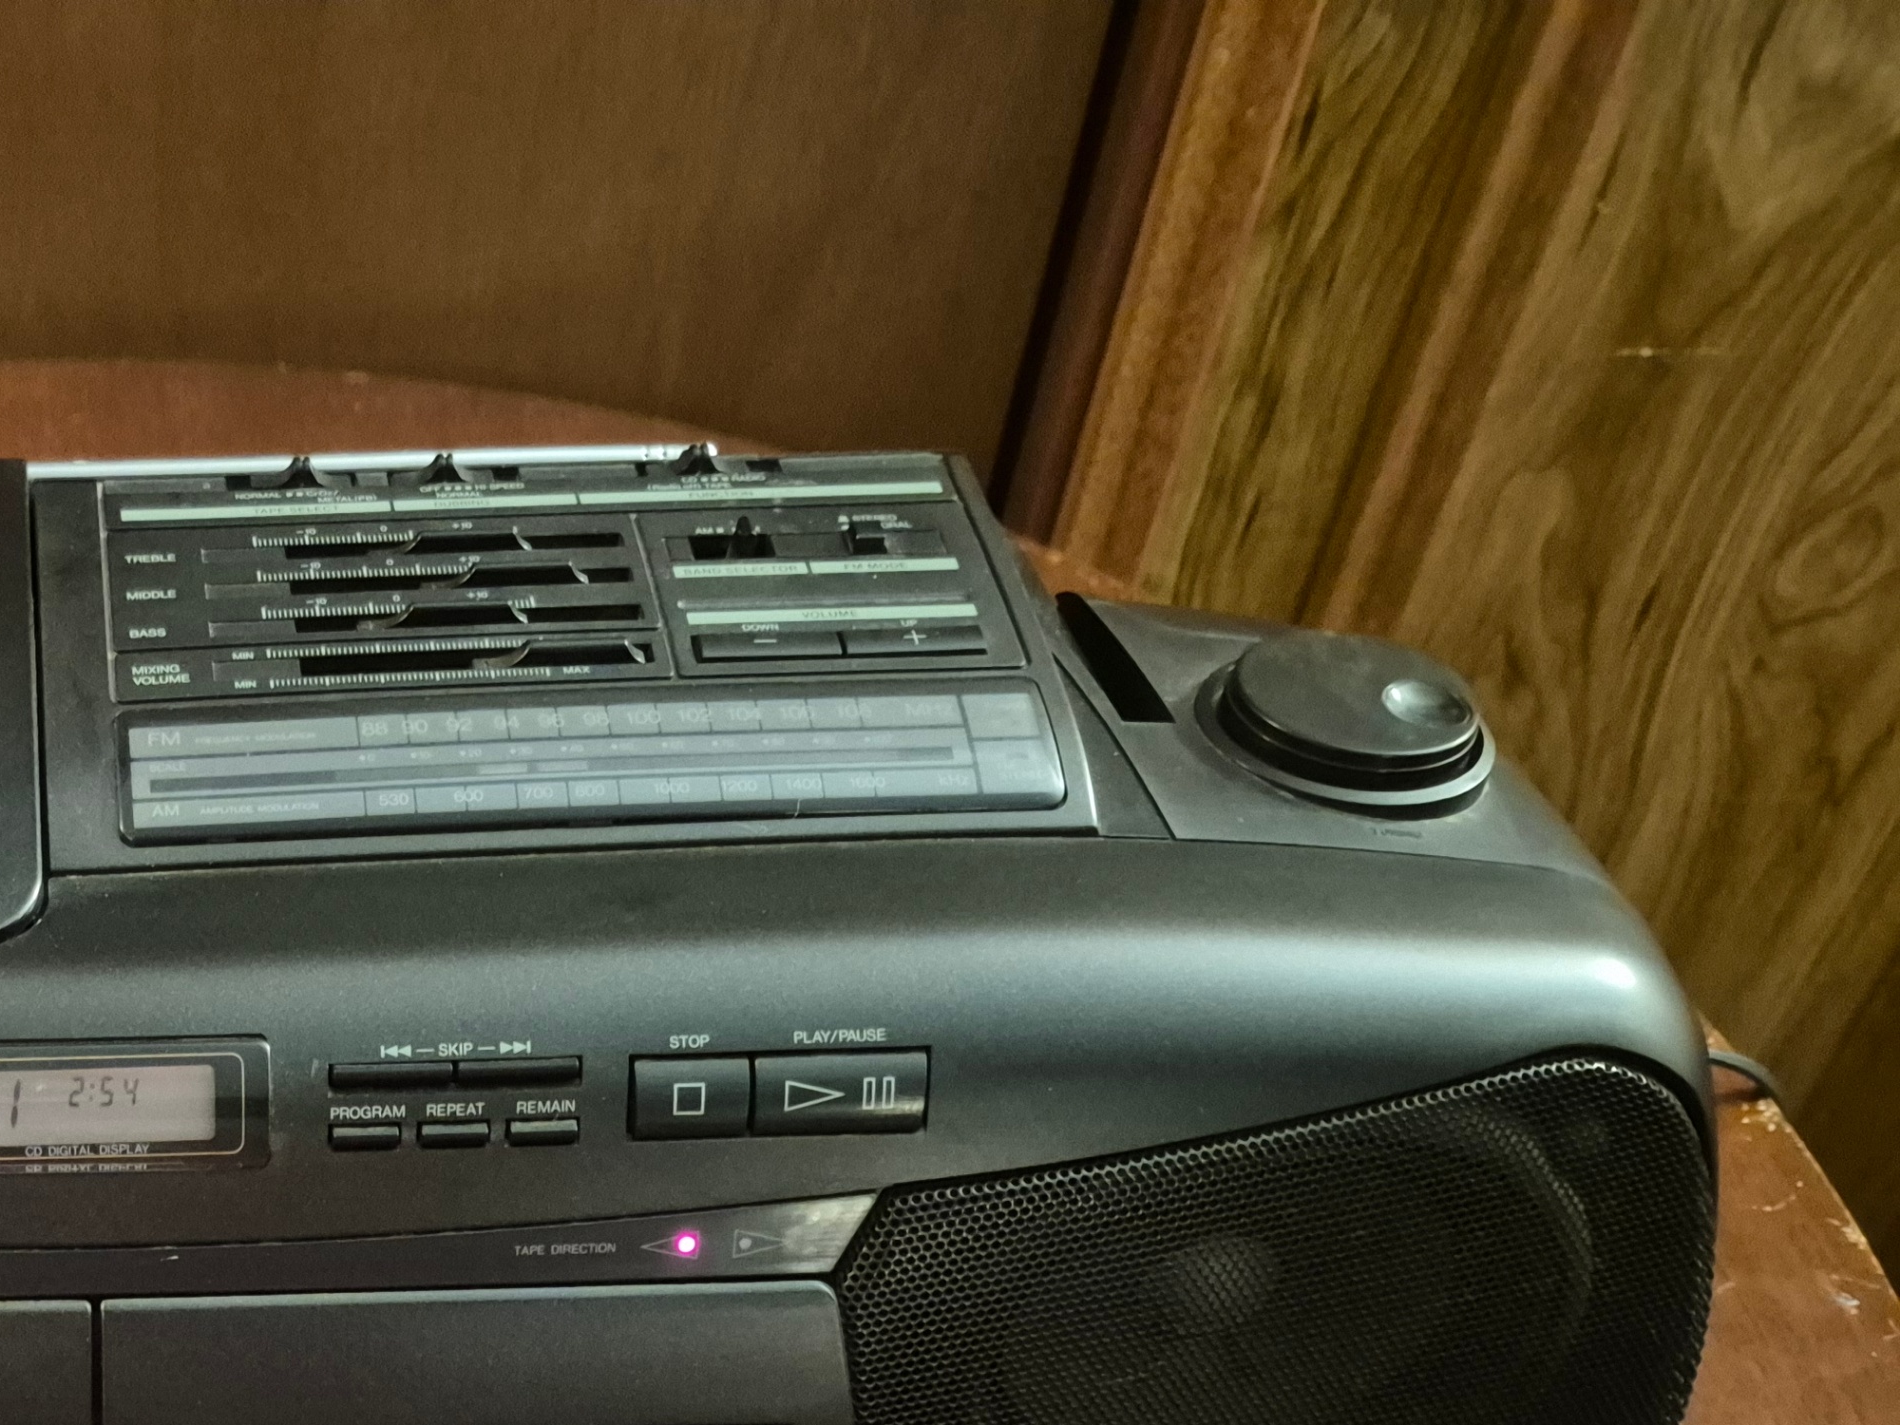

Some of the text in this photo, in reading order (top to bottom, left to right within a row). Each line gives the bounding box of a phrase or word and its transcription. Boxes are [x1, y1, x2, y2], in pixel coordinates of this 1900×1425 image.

[235, 491, 281, 500] NORMAL
[125, 553, 177, 565] TREBLE
[865, 561, 907, 571] MODE
[683, 564, 798, 577] BAND SELECTOR
[126, 589, 177, 601] MIDDLE
[801, 609, 858, 619] VOLUME
[129, 627, 167, 639] BASS
[741, 619, 918, 633] DOWN UP
[232, 651, 255, 661] MIN
[131, 664, 181, 676] MIXING
[132, 673, 191, 686] VOLUME
[234, 665, 591, 690] MIN MAX
[148, 732, 181, 747] FM
[361, 721, 389, 736] 88
[402, 719, 429, 734] 90
[446, 717, 473, 732] 92
[627, 710, 662, 725] 100
[678, 708, 712, 723] 102
[728, 706, 761, 721] 104
[904, 702, 953, 717] MHz
[152, 804, 180, 817] AM
[379, 793, 409, 807] 530
[454, 789, 484, 803] 600
[524, 786, 554, 800] 700
[575, 784, 605, 798] 800
[654, 781, 691, 794] 1000
[722, 780, 758, 793] 1200
[785, 778, 822, 791] 1400
[849, 776, 886, 789] 1600
[938, 773, 969, 786] kHz
[668, 1033, 711, 1050] STOP
[793, 1027, 888, 1046] PLAY/PAUSE
[437, 1041, 474, 1058] SKIP
[67, 1075, 141, 1109] 2:54
[329, 1104, 407, 1120] PROGRAM
[425, 1102, 486, 1117] REPEAT
[516, 1100, 577, 1115] REMAIN
[25, 1144, 150, 1157] CD DIGITAL DISPLAY
[514, 1242, 617, 1257] TAPE DIRECTION
